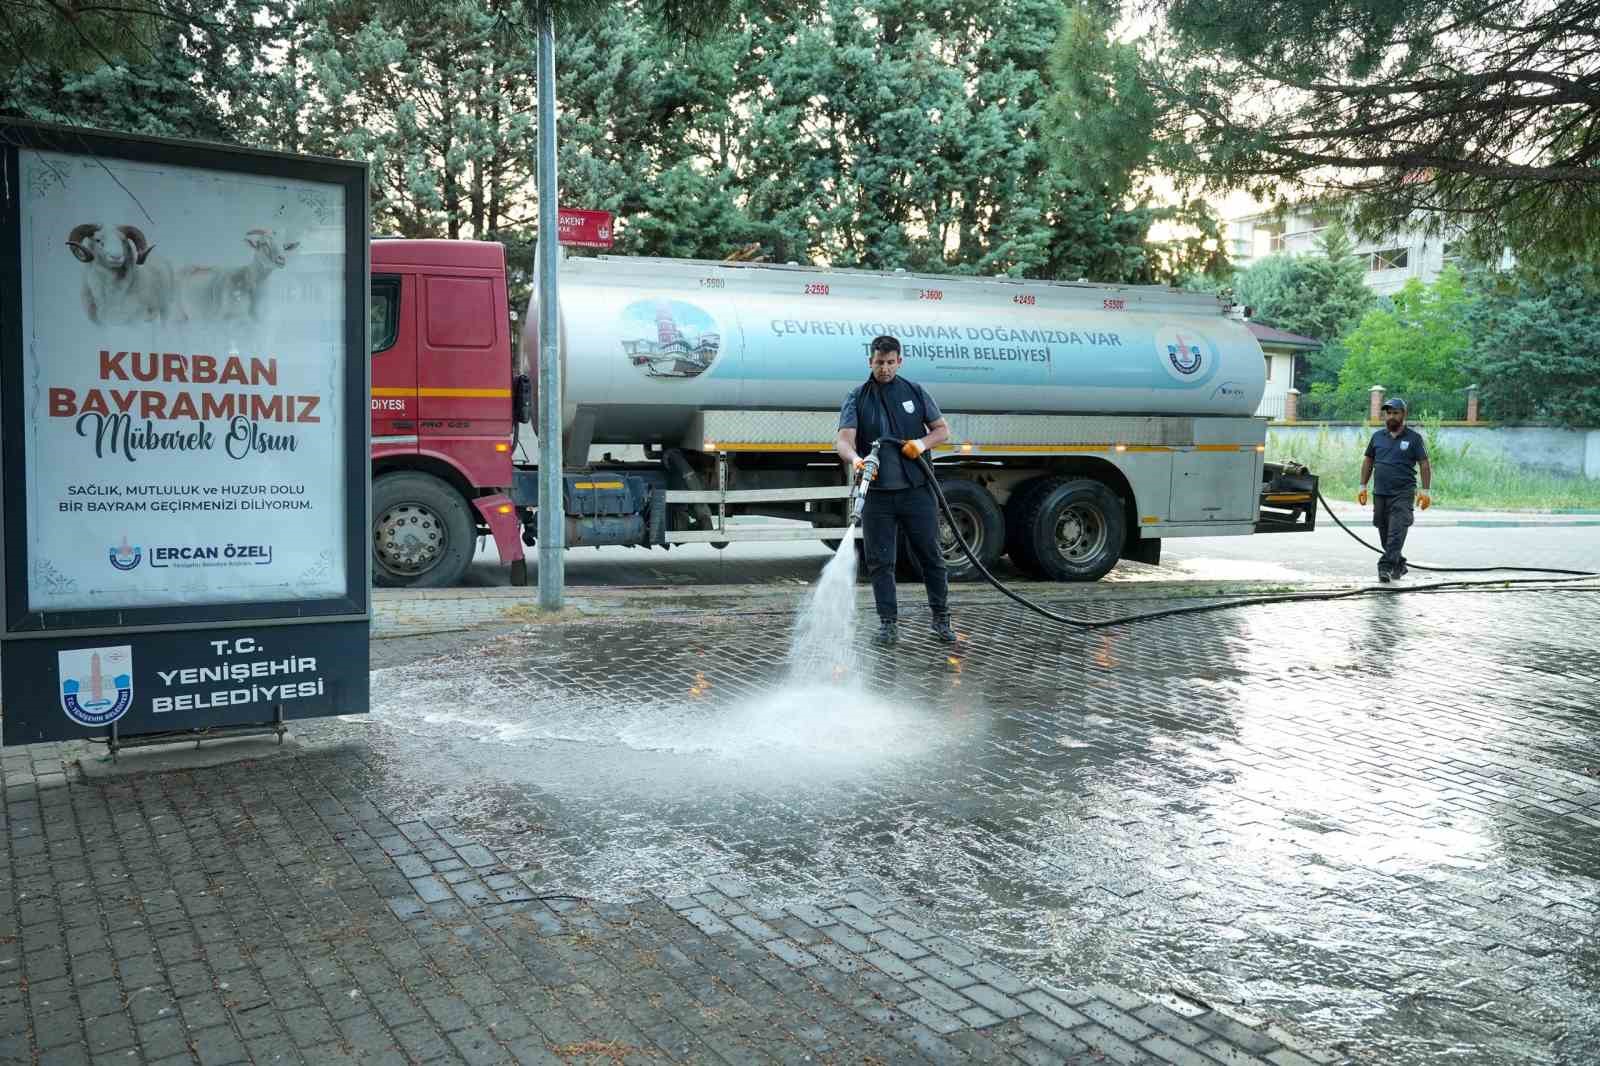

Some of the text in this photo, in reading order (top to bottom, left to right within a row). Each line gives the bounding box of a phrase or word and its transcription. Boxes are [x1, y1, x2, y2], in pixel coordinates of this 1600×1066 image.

[771, 319, 1122, 346] ÇEVREYİ KORUMAK DOĞAMIZDA VAR
[899, 342, 1051, 363] ENİŞEHİR BELEDİYESİ
[99, 350, 278, 386] KURBAN
[49, 387, 321, 424] BAYRAMIMIZ
[75, 412, 298, 462] Mübarek Olsun
[68, 483, 305, 496] SAĞLIK, MUTLULUK ve HUZUR DOLU
[59, 498, 313, 514] BİR BAYRAM GEÇİRMENİZİ DİLİYORUM.
[156, 544, 268, 560] ERCAN ÖZEL
[210, 638, 264, 656] T.C.
[156, 656, 318, 686] YENİŞEHİR
[152, 678, 324, 713] BELEDİYESİ
